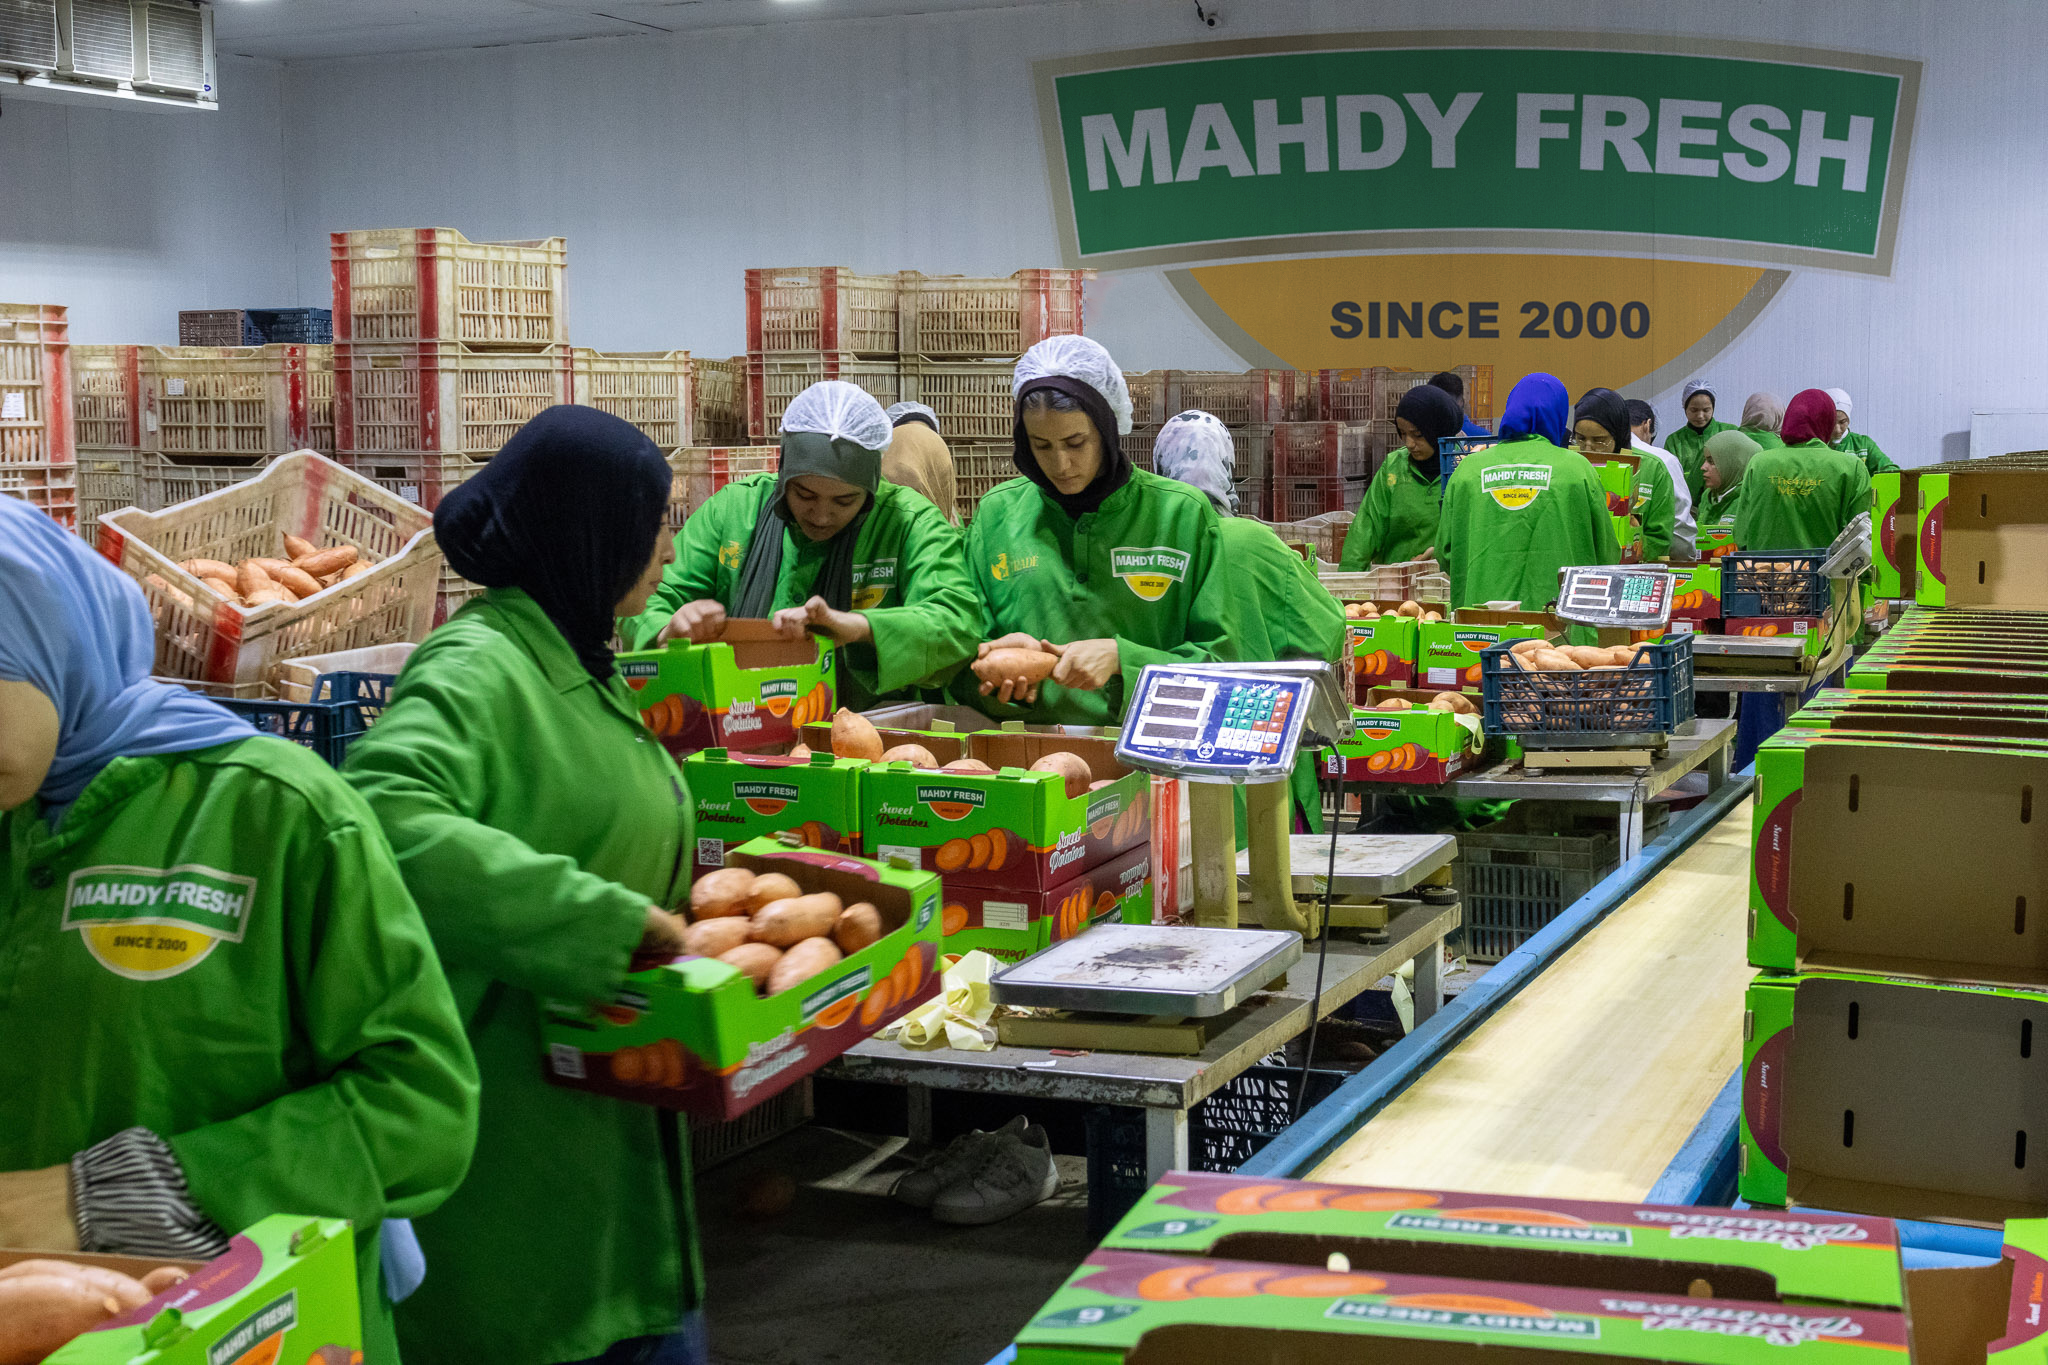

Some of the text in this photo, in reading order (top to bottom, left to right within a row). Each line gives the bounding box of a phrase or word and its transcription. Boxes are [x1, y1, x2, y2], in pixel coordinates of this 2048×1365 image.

[1081, 91, 1875, 193] MAHDY FRESH
[1329, 300, 1651, 340] SINCE 2000
[1484, 471, 1548, 483] MAHDY FRESH
[1116, 554, 1185, 571] MAHDY FRESH
[1427, 648, 1462, 658] Potatoes
[1429, 641, 1453, 650] Sweet
[630, 664, 657, 674] FRESH
[761, 681, 797, 695] MAHDY FRESH
[729, 697, 756, 716] Sweet
[723, 714, 762, 736] Potatoes
[1379, 720, 1400, 728] FRESH
[736, 785, 797, 797] MAHDY FRESH
[920, 789, 983, 802] MAHDY FRESH
[698, 798, 731, 811] Sweet
[879, 802, 914, 815] Sweet
[1088, 800, 1119, 820] MAHDY FRESH
[695, 810, 746, 824] Potatoes
[876, 813, 928, 828] Potatoes
[1056, 826, 1081, 851] Sweet
[1772, 824, 1783, 851] Sweet
[1049, 844, 1086, 875] Potatoes
[72, 881, 244, 917] MAHDY FRESH
[113, 935, 188, 951] SINCE 2000
[1760, 1061, 1770, 1088] Sweet
[1399, 1215, 1620, 1241] MAHDY FRESH
[1342, 1303, 1587, 1333] MAHDY FRESH
[213, 1300, 294, 1365] MAHDY FRESH
